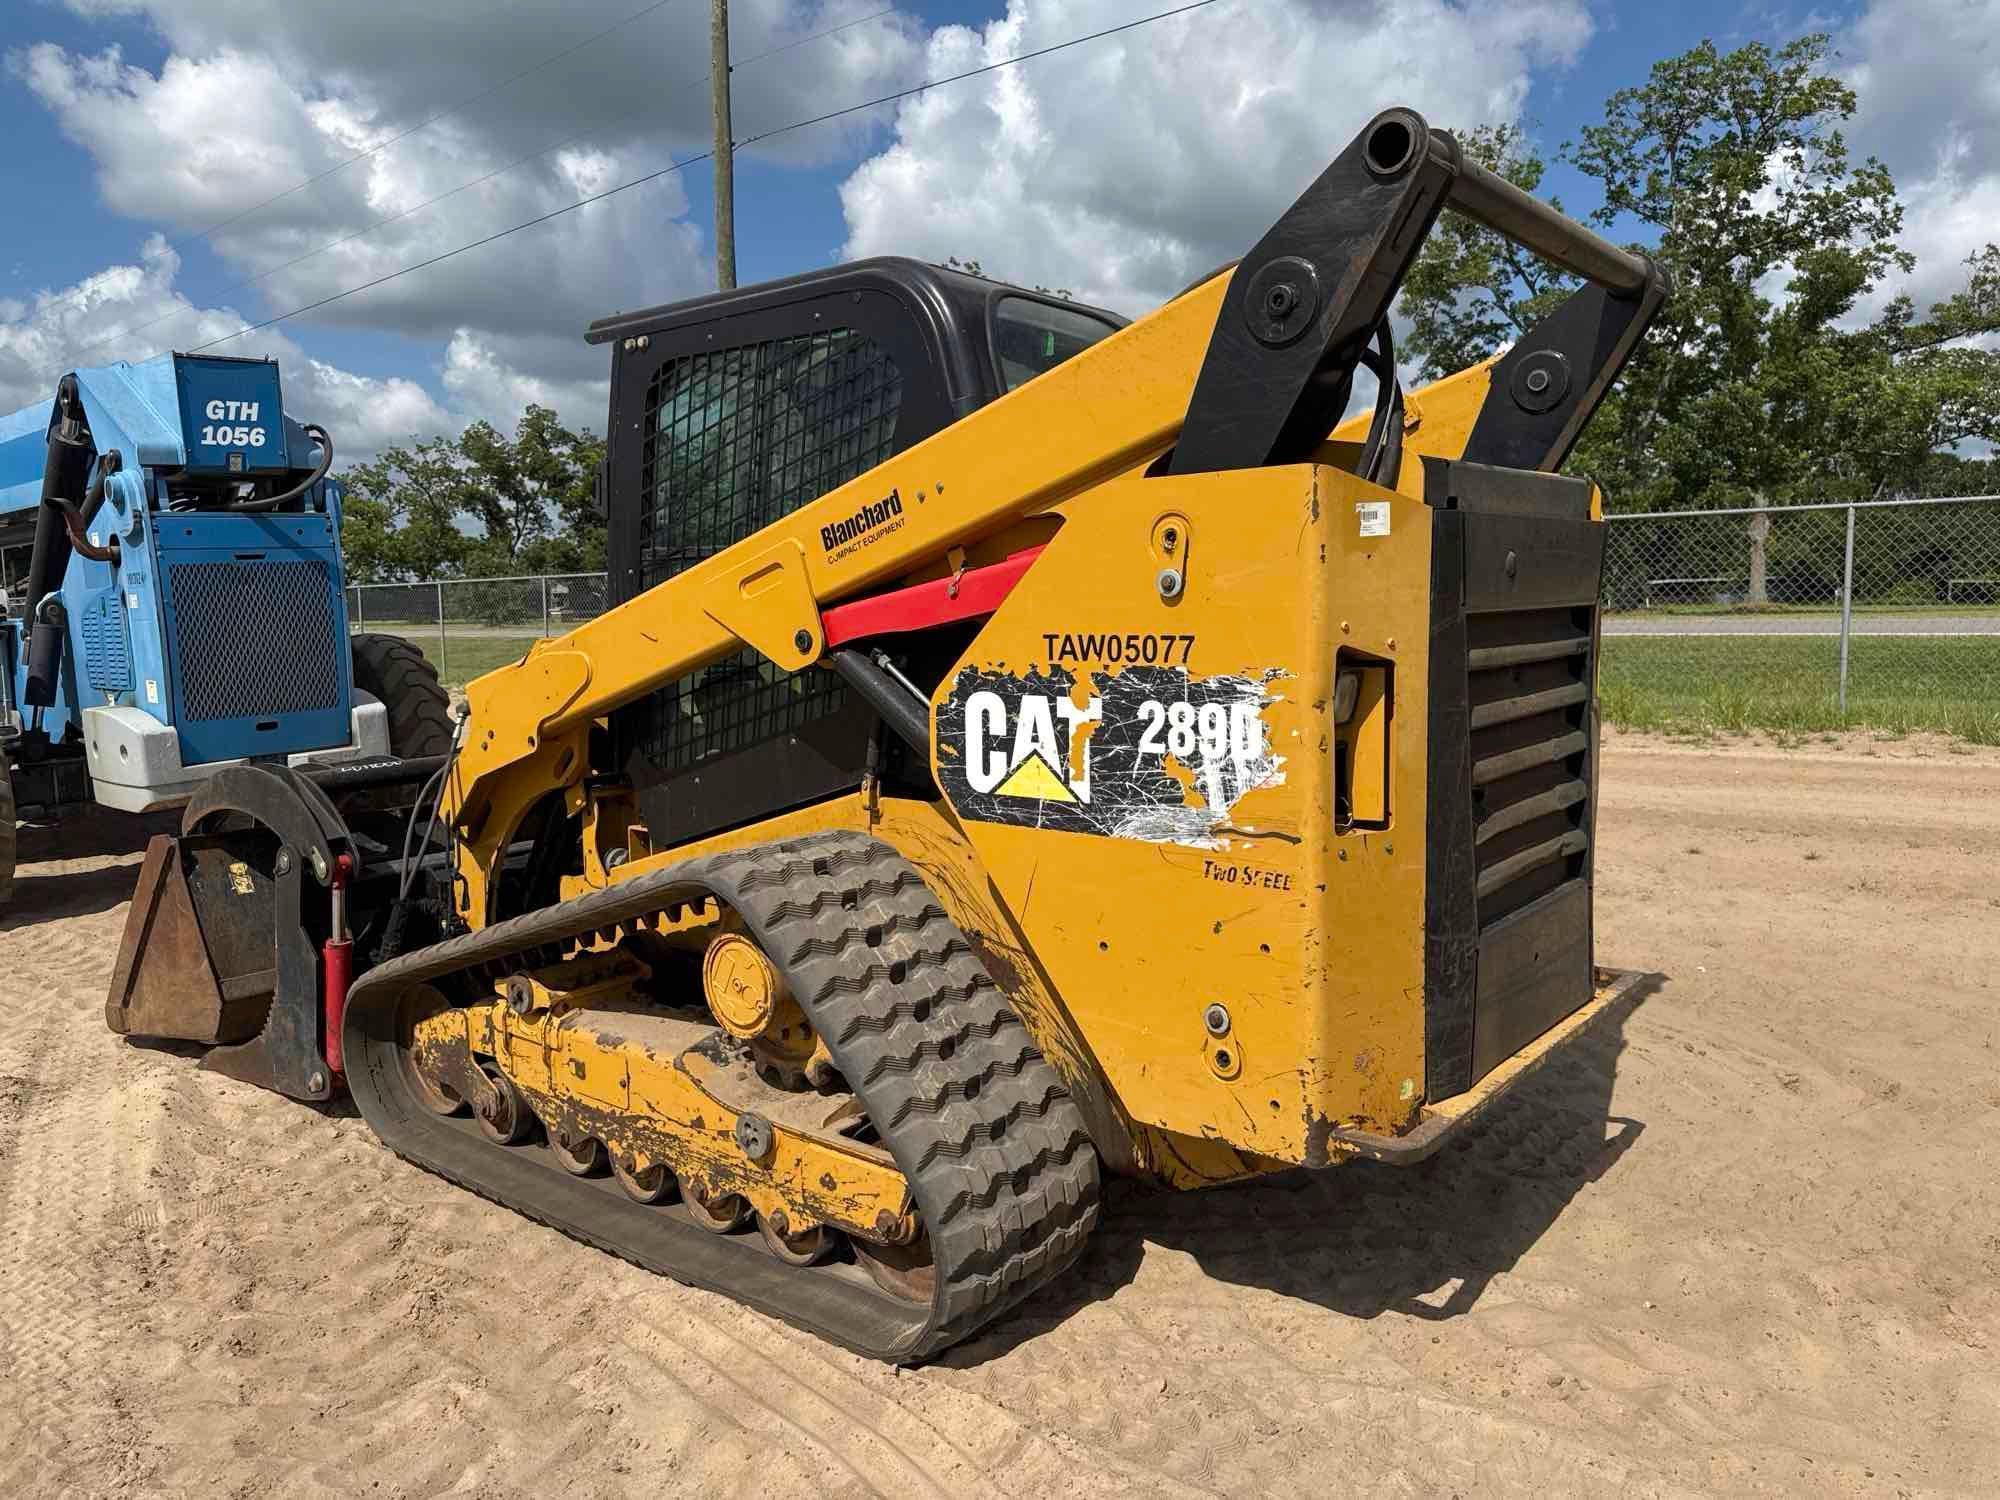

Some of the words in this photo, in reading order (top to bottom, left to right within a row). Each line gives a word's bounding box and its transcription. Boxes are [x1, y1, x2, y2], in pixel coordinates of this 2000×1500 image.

[206, 400, 259, 421] GTH
[201, 426, 266, 447] 1056
[821, 488, 903, 552] Blanchard
[828, 541, 861, 565] COMPACT
[863, 518, 905, 547] EQUIPMENT
[1043, 634, 1195, 663] TAW05077
[965, 691, 1103, 804] CAT
[1137, 700, 1264, 758] 289D
